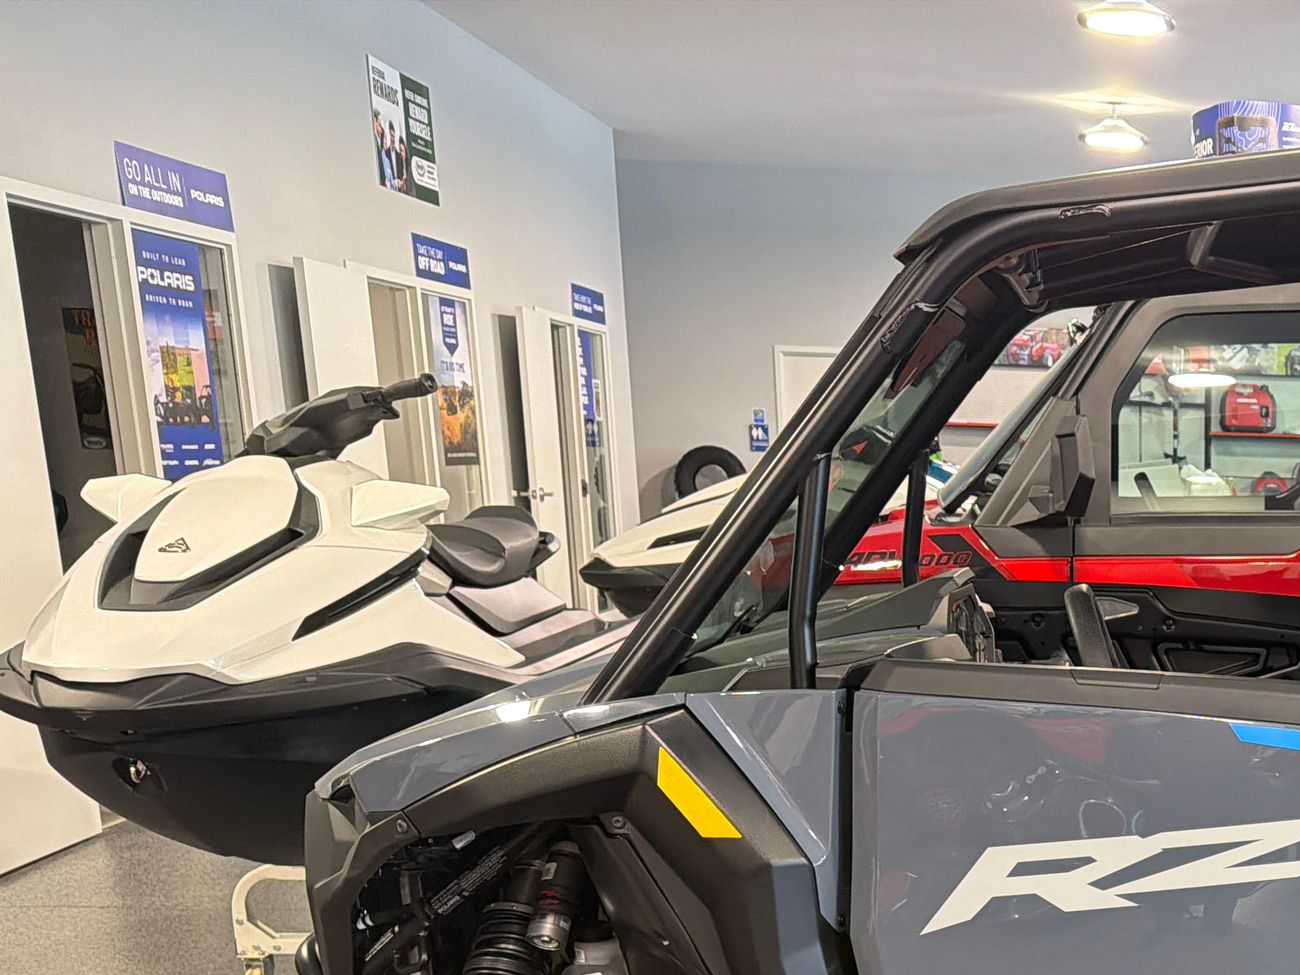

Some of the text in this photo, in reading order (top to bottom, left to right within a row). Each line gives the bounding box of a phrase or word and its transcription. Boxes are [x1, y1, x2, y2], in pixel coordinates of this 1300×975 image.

[372, 77, 399, 107] REWARDS
[123, 157, 182, 193] GO ALL IN
[128, 182, 184, 208] ON THE OUTDOORS
[190, 189, 225, 207] POLARIS
[142, 250, 186, 267] BUILT TO LEAD
[418, 255, 445, 275] OFF ROAD
[448, 260, 467, 273] POLARIS
[137, 265, 195, 291] POLARIS
[168, 297, 176, 306] TO
